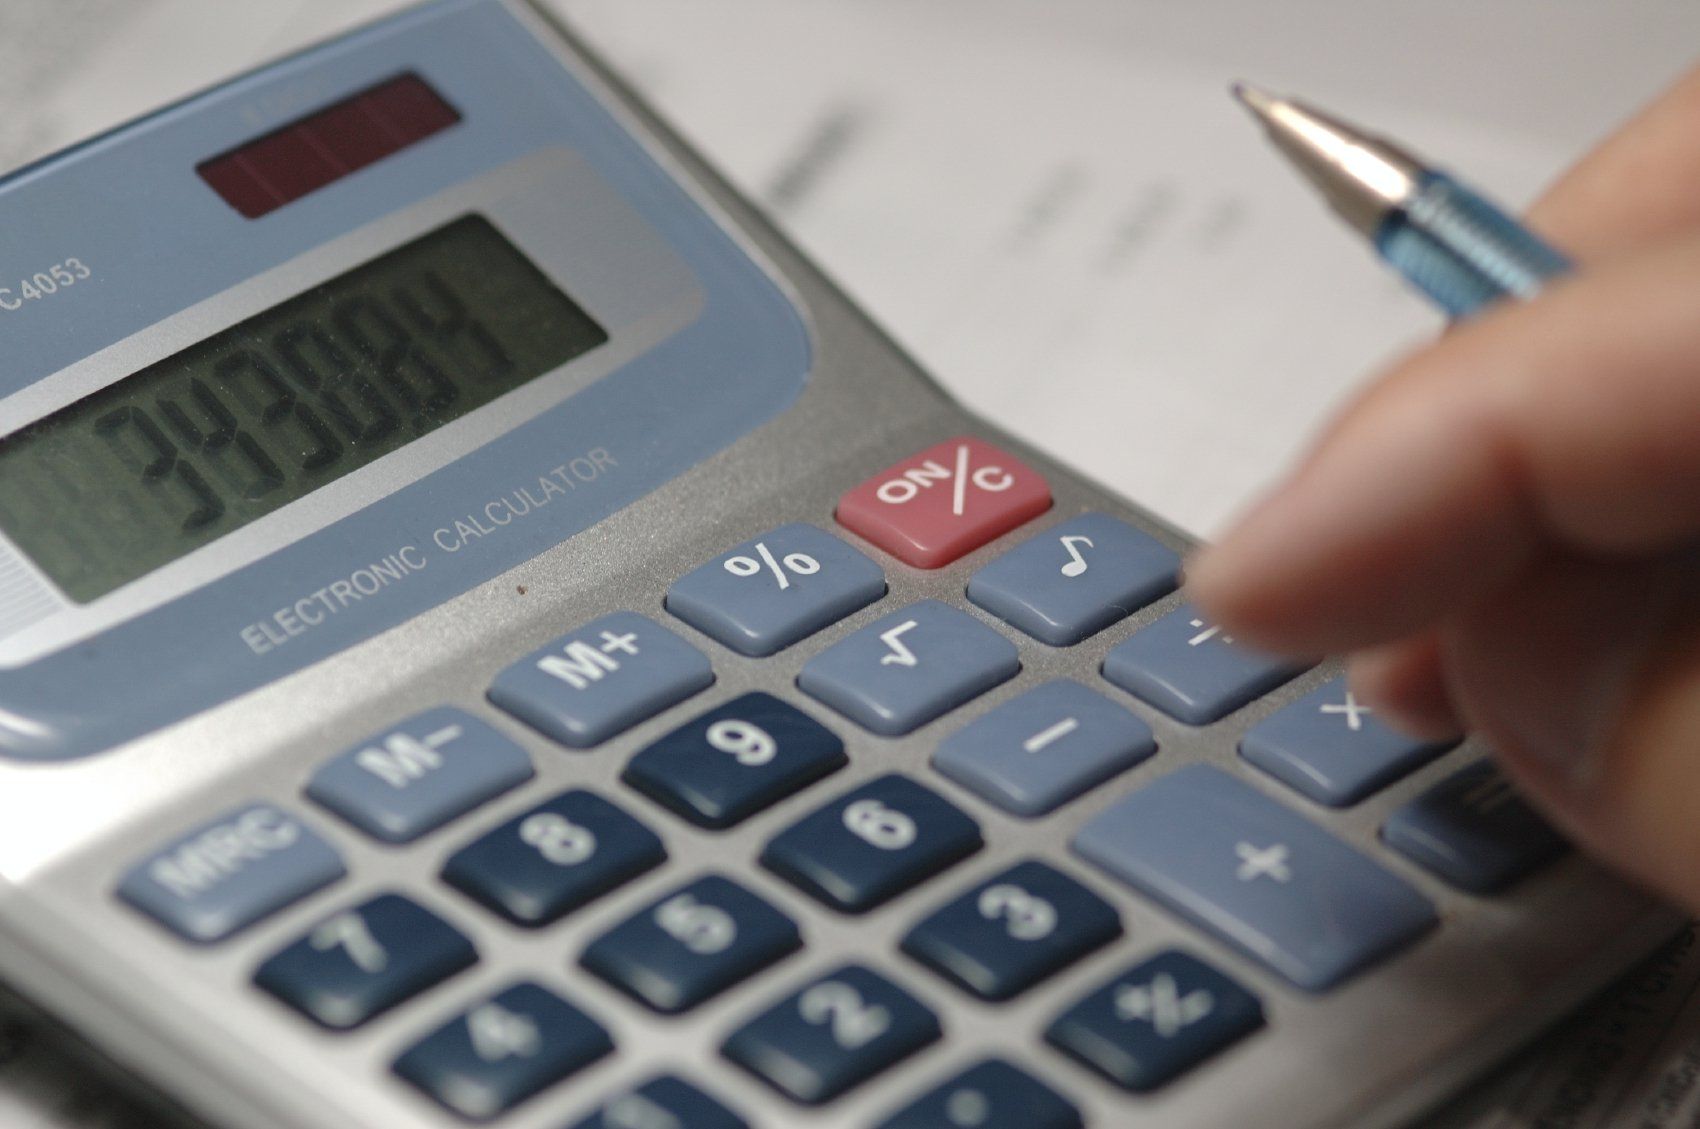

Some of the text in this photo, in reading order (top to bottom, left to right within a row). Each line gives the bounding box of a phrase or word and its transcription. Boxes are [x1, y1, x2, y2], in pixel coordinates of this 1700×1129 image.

[239, 446, 619, 655] ELECTRONIC CALCULATOR
[536, 627, 640, 689] M+
[705, 719, 777, 766] 9
[150, 807, 299, 900] MRC
[518, 812, 596, 866] 8
[842, 799, 917, 850] 6
[310, 911, 388, 974] 7
[652, 893, 738, 955] 5
[977, 883, 1059, 941] 3
[466, 1003, 542, 1062] 4
[799, 980, 891, 1049] 2
